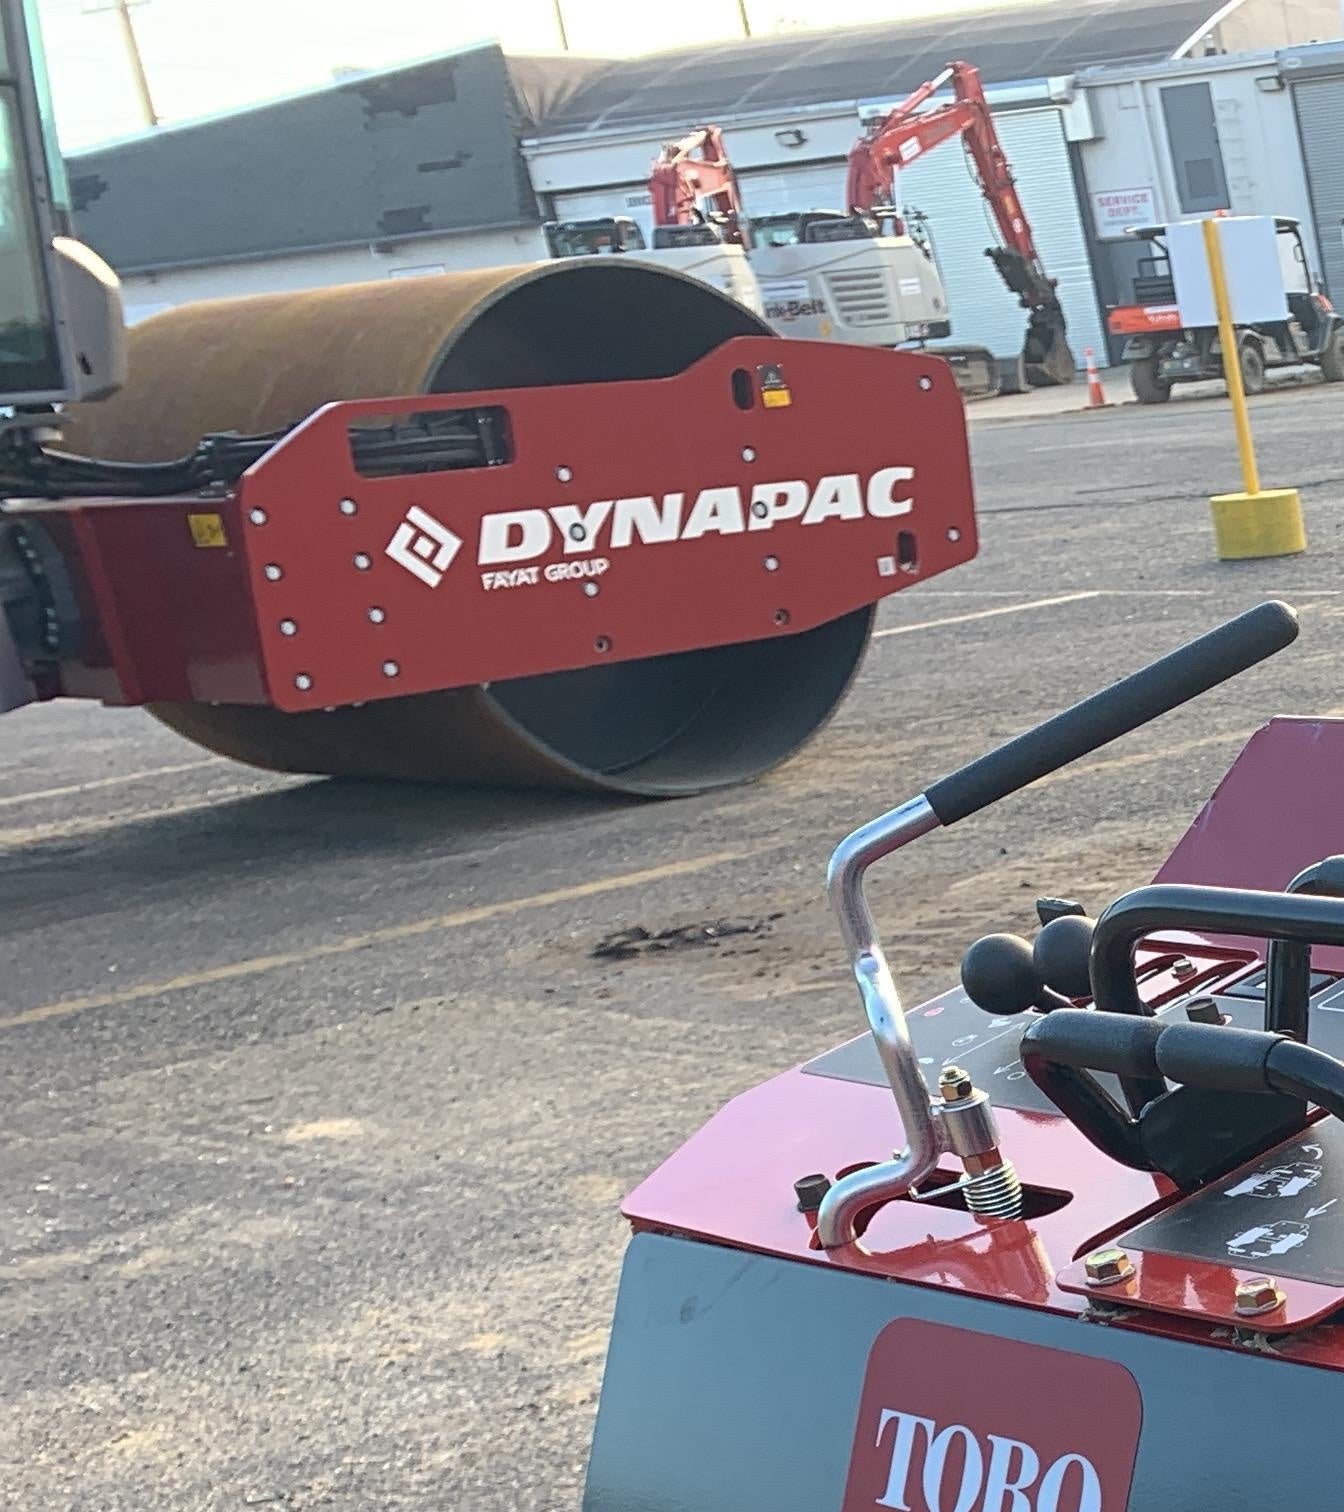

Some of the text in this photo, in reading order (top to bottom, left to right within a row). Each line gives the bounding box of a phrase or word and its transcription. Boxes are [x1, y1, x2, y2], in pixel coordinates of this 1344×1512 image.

[477, 466, 914, 566] DYNAPAC
[481, 557, 611, 591] FAYAT GROUP
